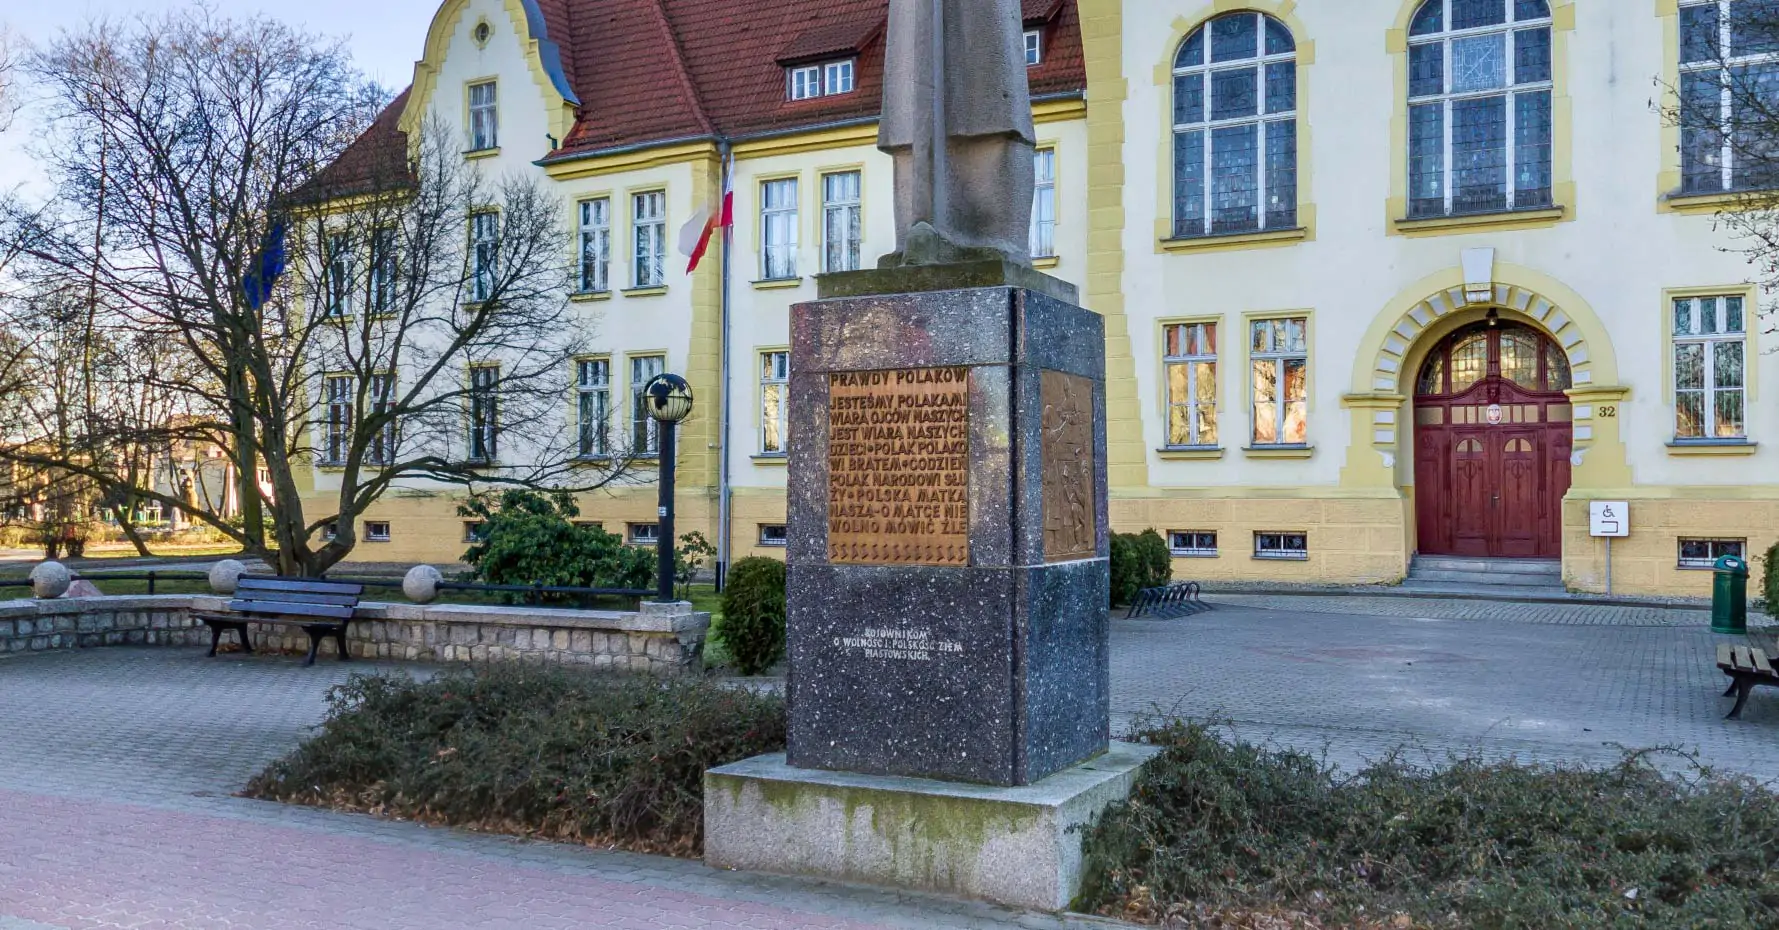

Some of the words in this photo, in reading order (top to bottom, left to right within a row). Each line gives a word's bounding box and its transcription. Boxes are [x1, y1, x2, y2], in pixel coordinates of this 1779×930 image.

[831, 371, 889, 387] PRAWDY
[830, 393, 894, 409] JESTEŚMY
[898, 392, 966, 408] POLAKAMI
[830, 412, 869, 425] WIARA
[871, 408, 911, 424] OJCÓW
[913, 410, 967, 423] NASZYCH
[1599, 406, 1615, 417] 32
[830, 427, 858, 440] JEST
[862, 427, 903, 440] WIARĄ
[907, 425, 967, 439] NASZYCH
[830, 443, 866, 456] DZIECI
[874, 441, 915, 455] POLAK
[918, 441, 967, 454] POLAKO
[830, 458, 844, 471] WI
[849, 457, 900, 470] BRATEM
[830, 473, 869, 486] POLAK
[873, 473, 940, 486] NARODOWI
[945, 473, 967, 486] SŁU
[857, 489, 912, 502] POLSKA
[917, 489, 967, 503] MATKĄ
[893, 505, 940, 518] MATCE
[945, 506, 967, 518] NIE
[830, 520, 879, 533] WOLNO
[885, 517, 935, 534] MÓWIĆ
[938, 642, 962, 651] ZIEM
